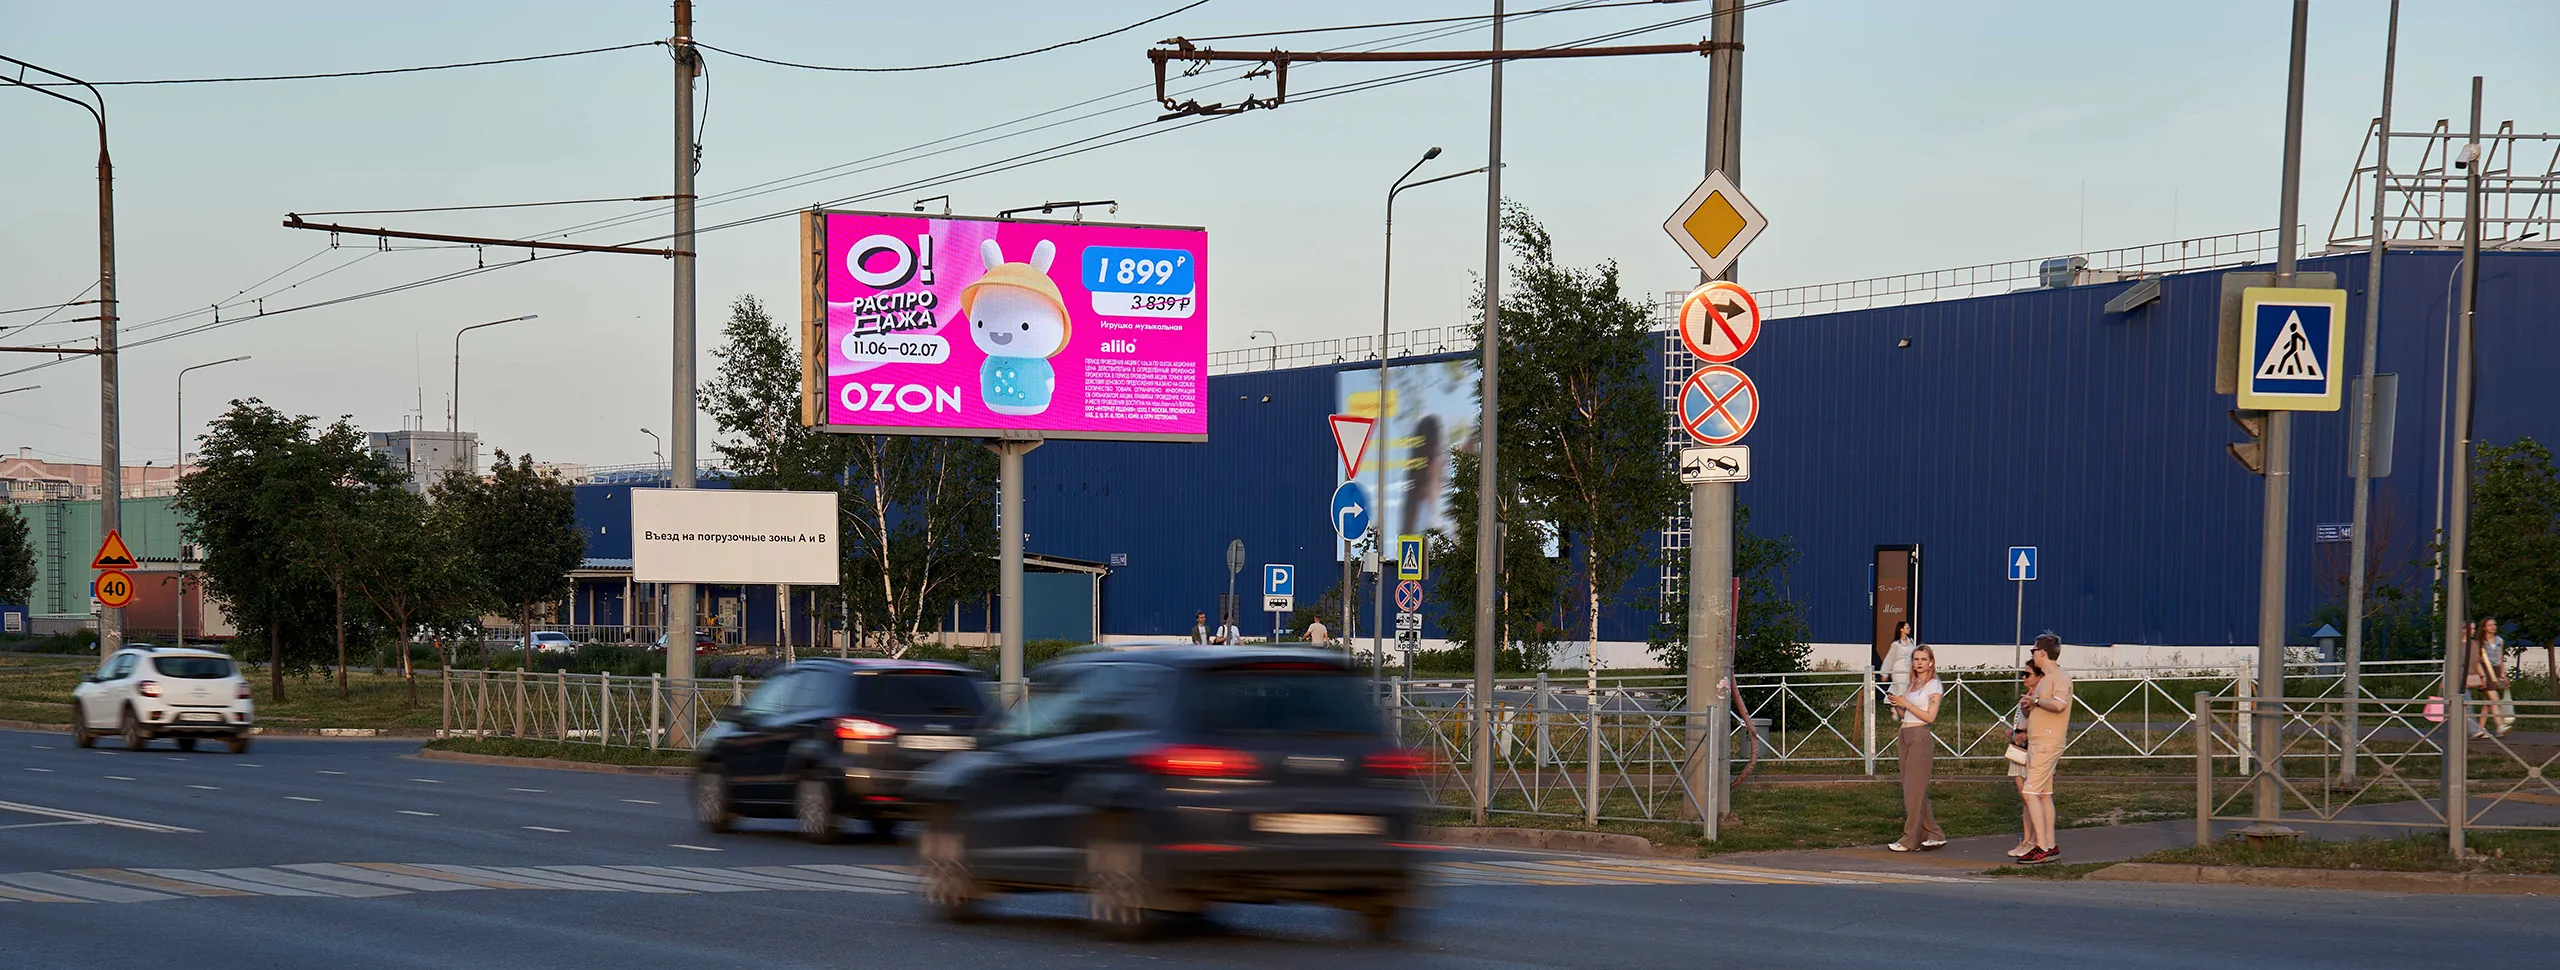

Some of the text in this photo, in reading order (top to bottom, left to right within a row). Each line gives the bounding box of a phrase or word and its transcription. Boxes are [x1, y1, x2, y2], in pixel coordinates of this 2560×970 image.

[853, 290, 936, 315] РАСПРО
[852, 310, 935, 335] ДАЖА
[1100, 321, 1183, 331] Игрушка музыкальная
[841, 382, 961, 413] OZON
[645, 531, 680, 542] Въезд
[682, 533, 695, 541] на
[697, 533, 766, 544] погрузочные
[769, 534, 796, 543] зоны
[809, 535, 816, 543] и
[103, 581, 126, 597] 40
[1272, 568, 1289, 592] P
